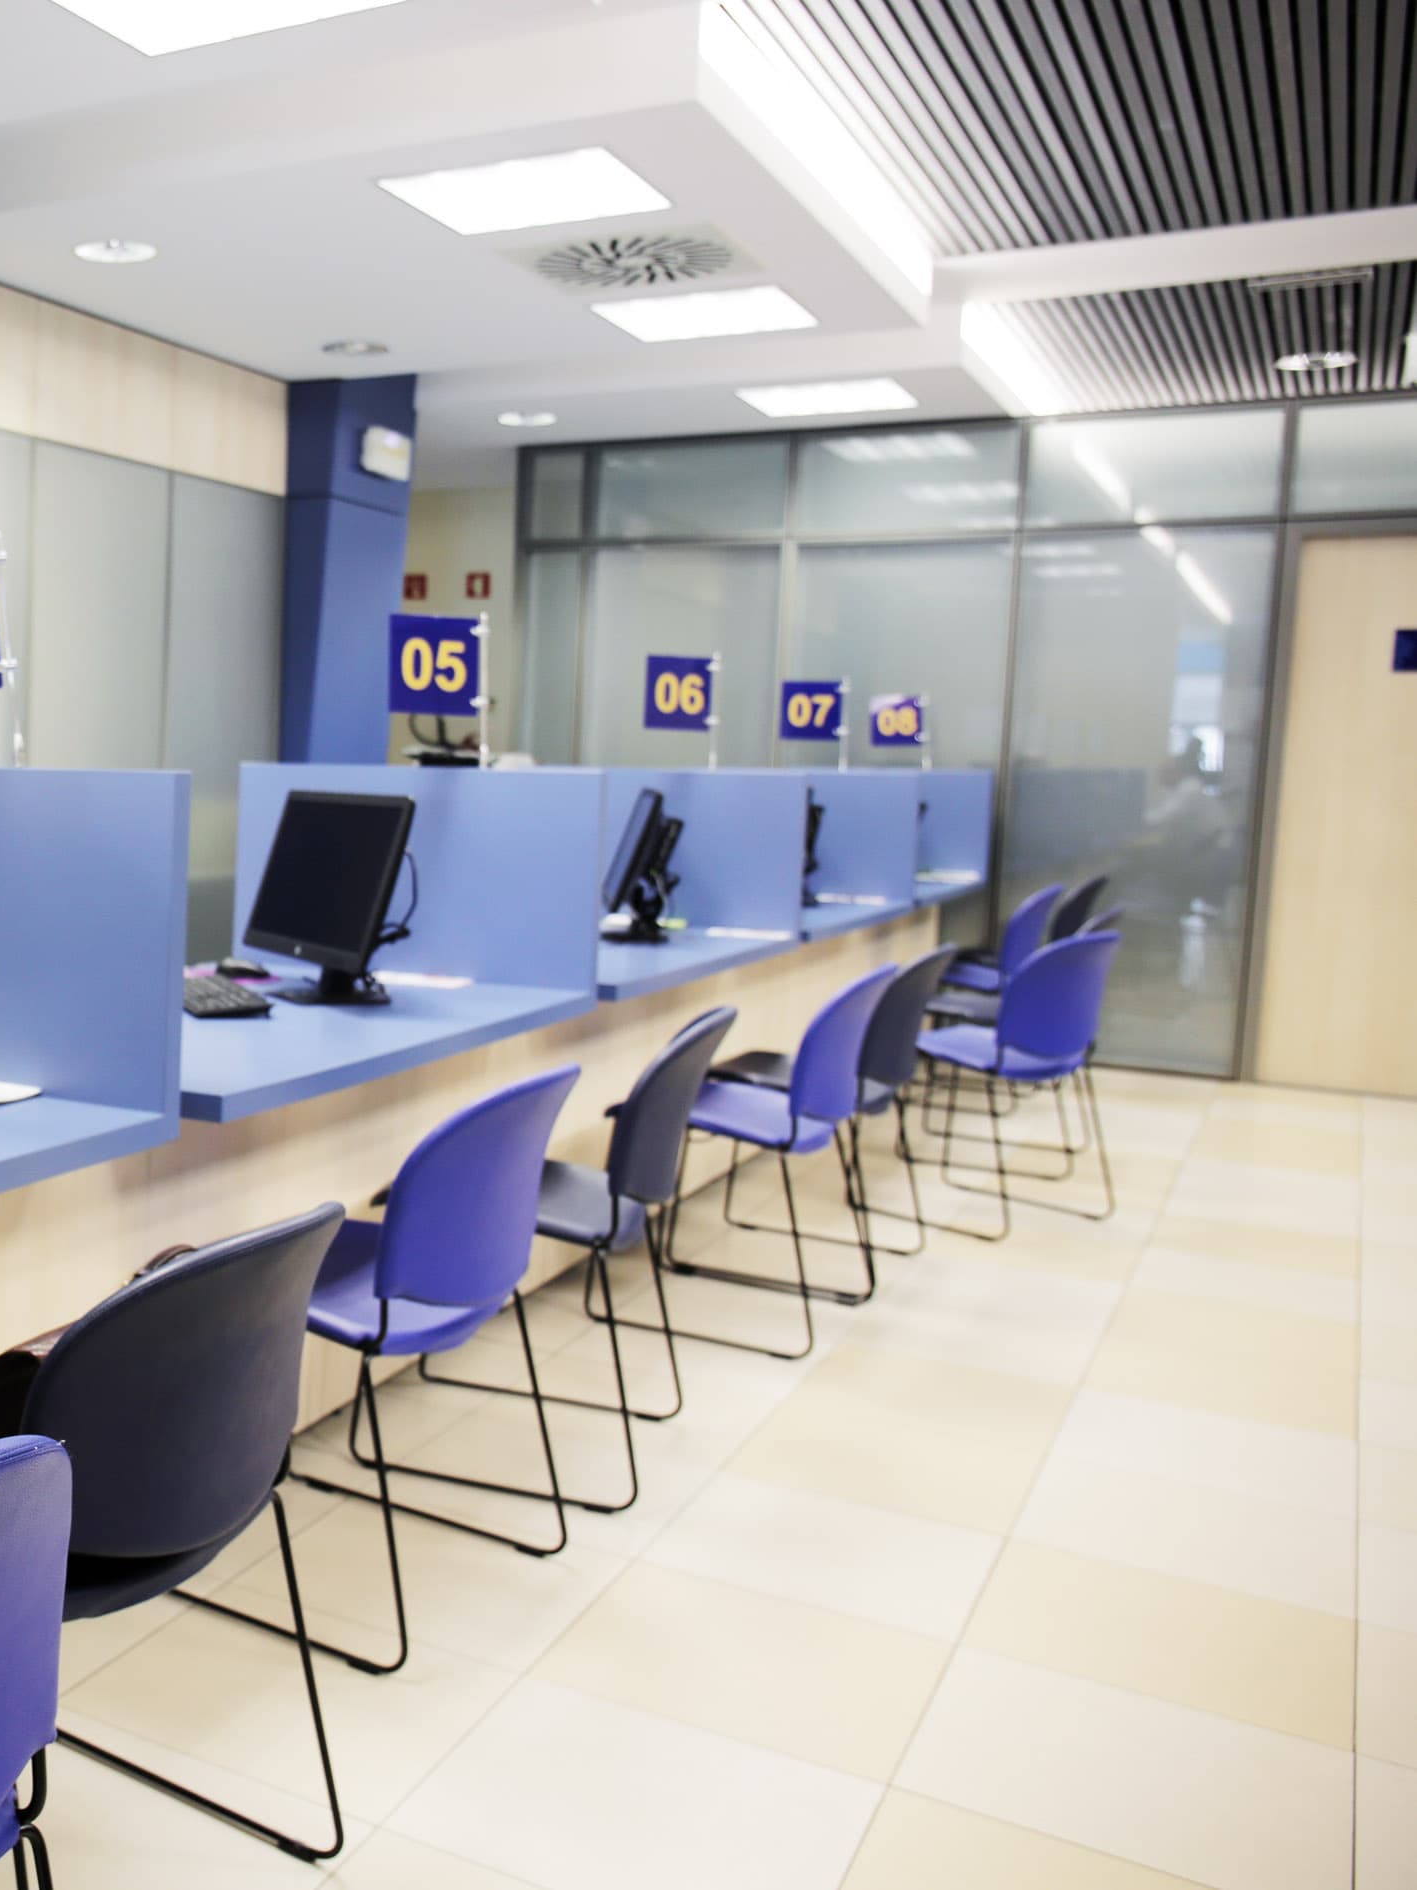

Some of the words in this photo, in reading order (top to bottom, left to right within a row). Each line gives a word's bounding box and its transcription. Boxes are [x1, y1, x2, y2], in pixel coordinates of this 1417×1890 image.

[402, 638, 467, 692] 05
[655, 672, 705, 715] 06
[787, 694, 834, 728] 07
[877, 707, 918, 736] 08
